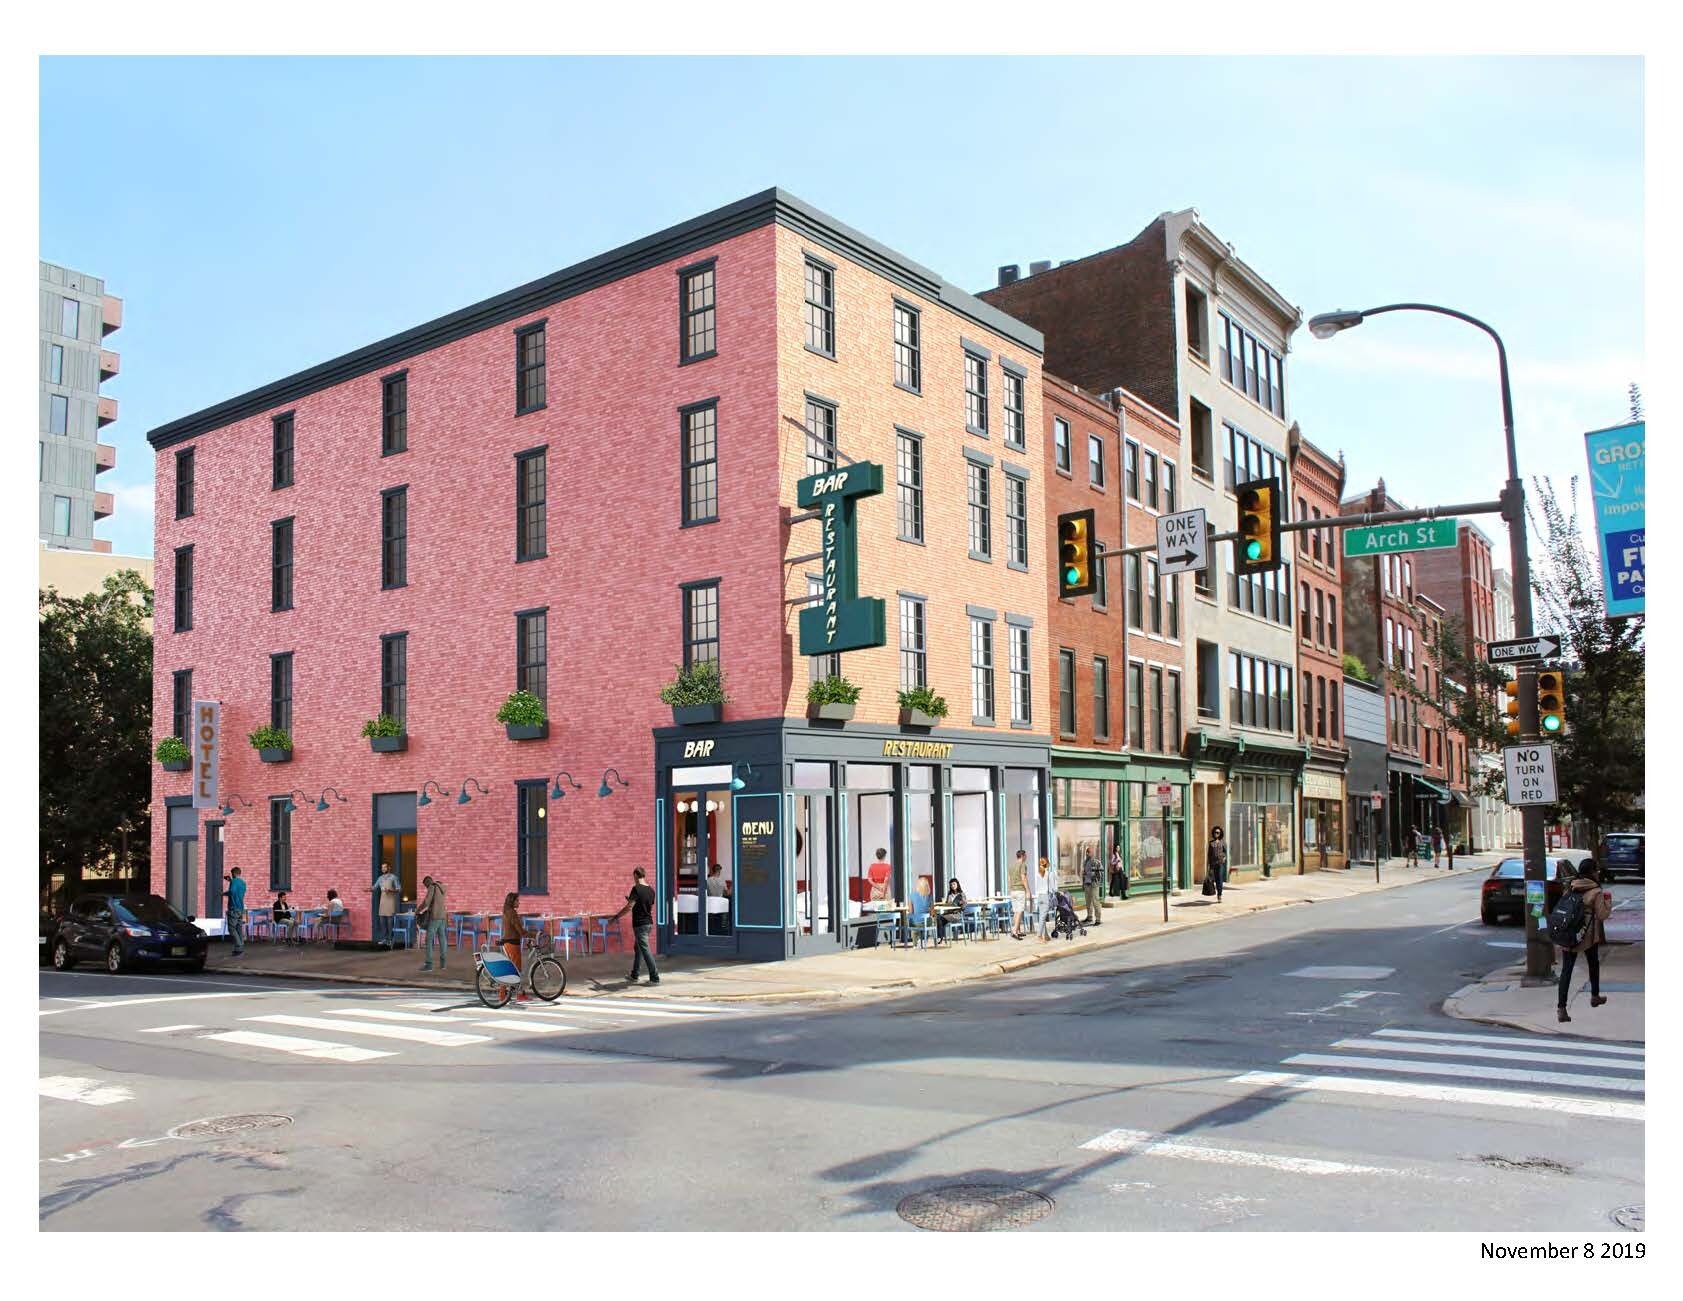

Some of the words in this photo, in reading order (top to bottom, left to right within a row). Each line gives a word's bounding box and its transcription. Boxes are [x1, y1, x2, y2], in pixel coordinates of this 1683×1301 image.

[812, 472, 848, 496] BAR
[1166, 516, 1196, 532] ONE
[1166, 531, 1197, 548] WAY
[1365, 529, 1409, 549] Arch
[1417, 527, 1436, 544] St
[825, 503, 837, 644] RESTAURANT
[1494, 647, 1515, 657] ONE
[1518, 644, 1538, 654] WAY
[198, 705, 215, 798] HOTEL
[684, 740, 715, 758] BAR
[882, 740, 953, 759] RESTAURANT
[1517, 751, 1539, 762] NO
[1515, 765, 1544, 775] TURN
[1523, 778, 1539, 787] ON
[1521, 790, 1543, 800] RED
[742, 821, 774, 835] MENU
